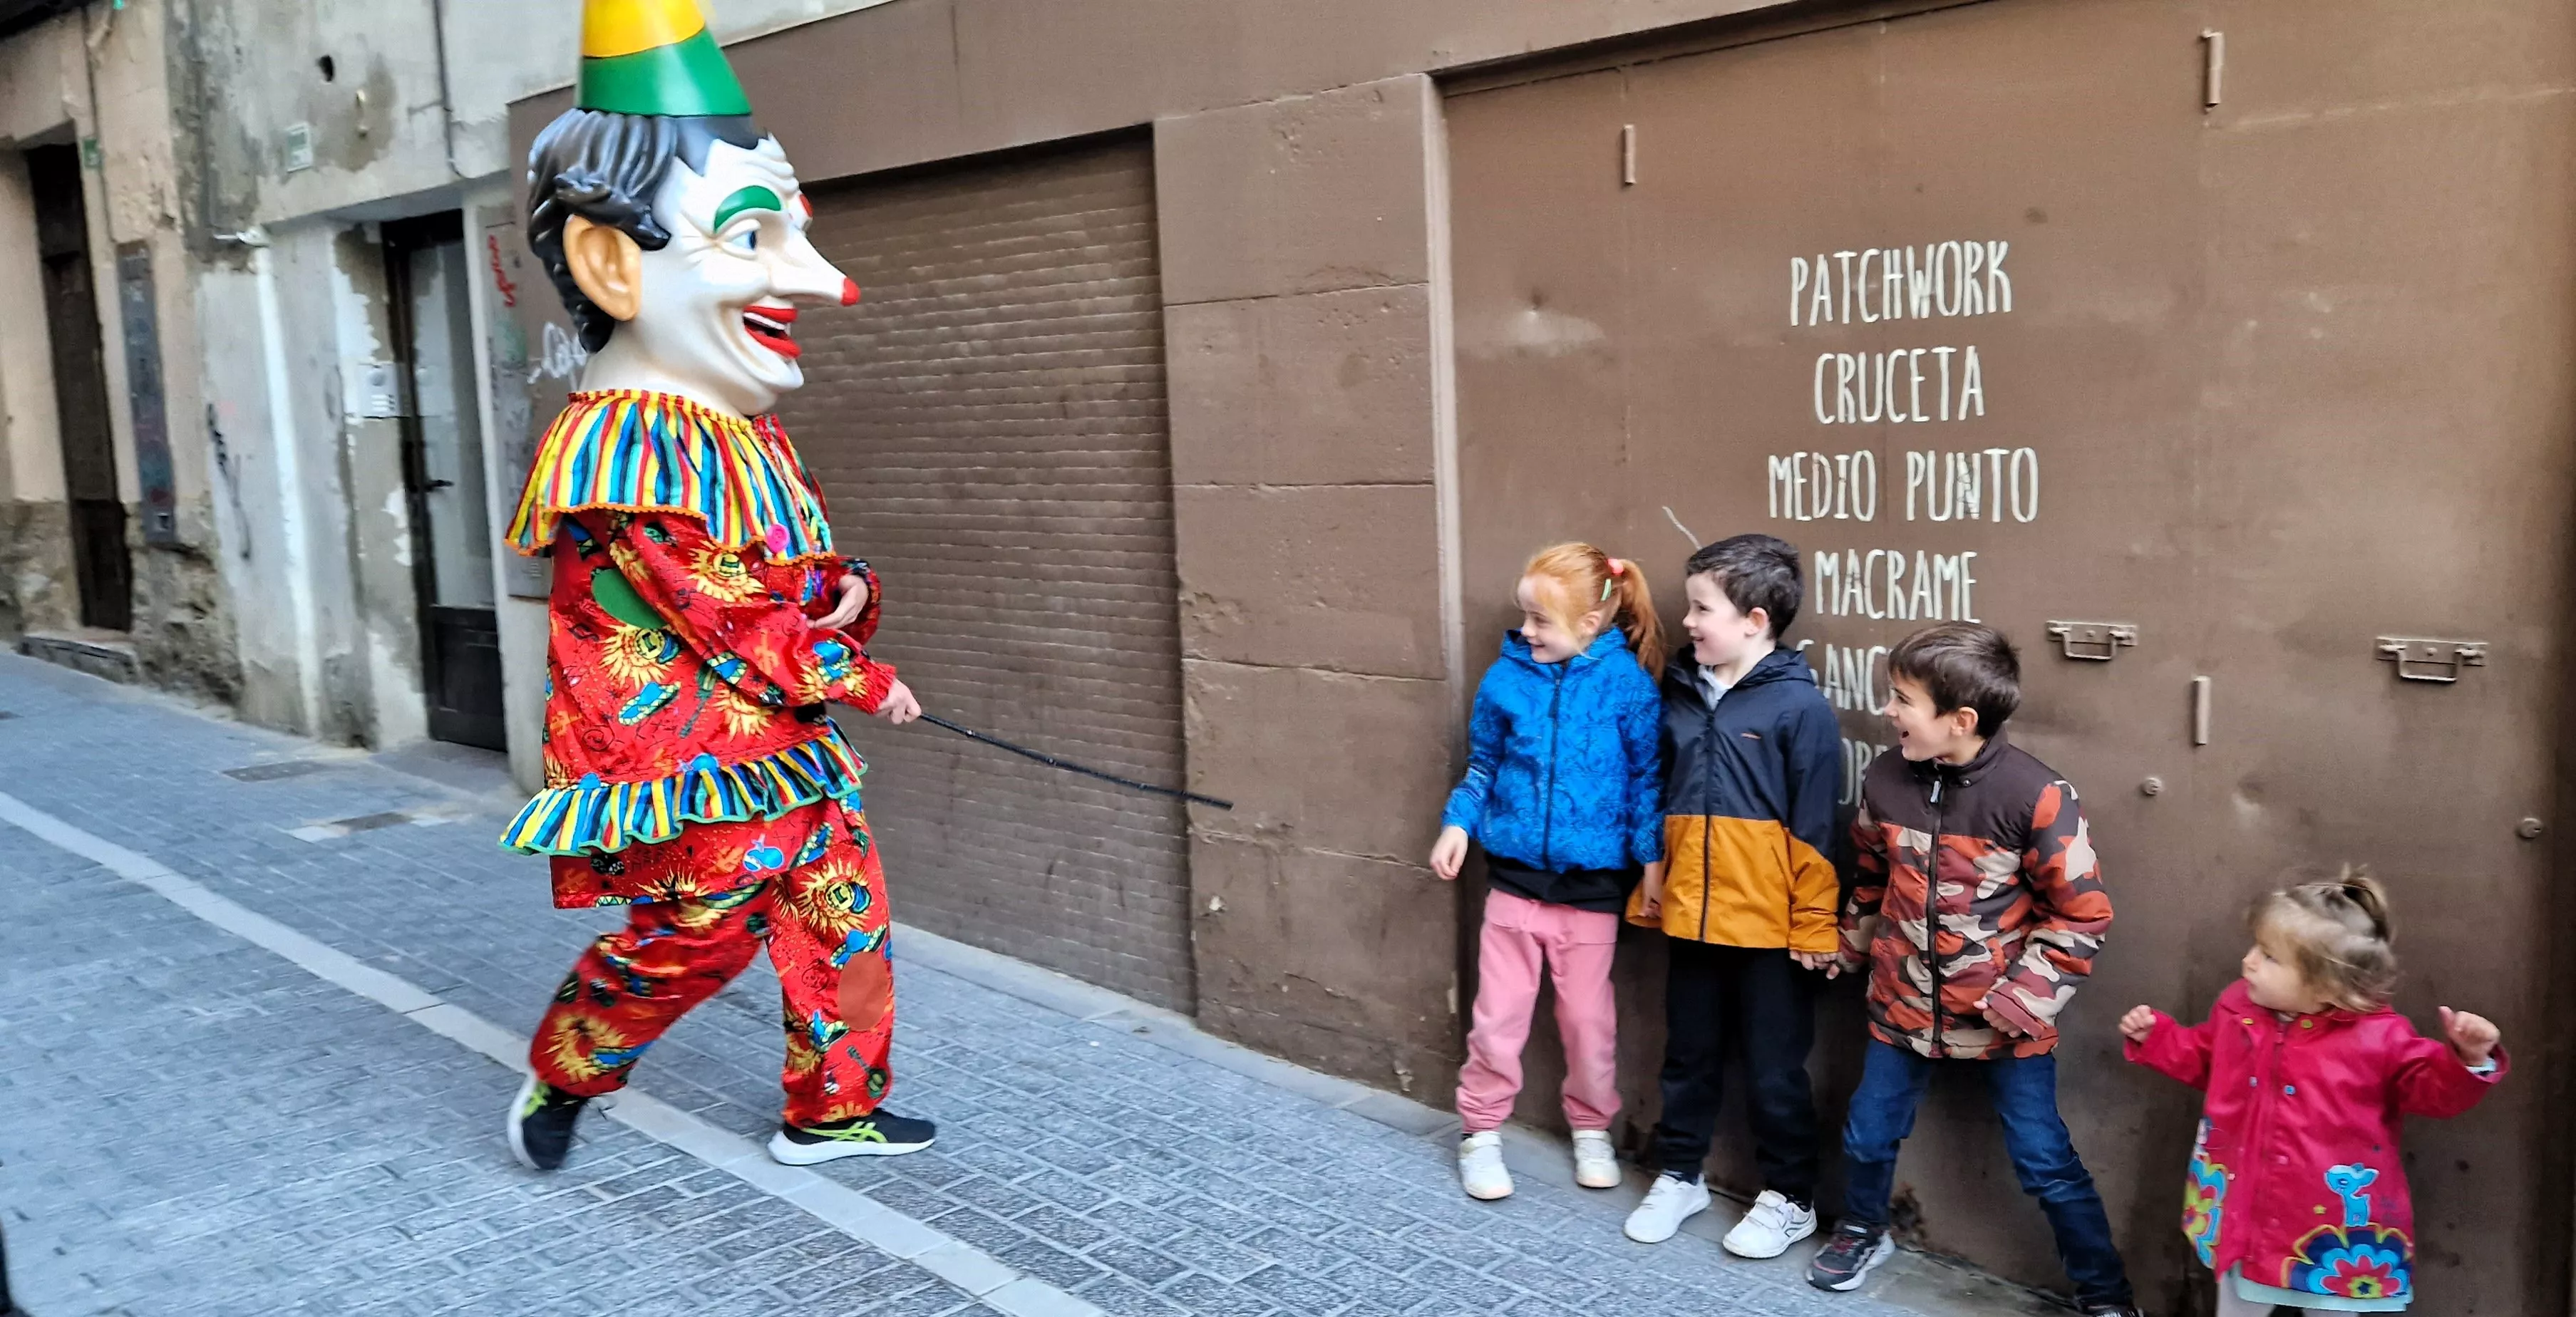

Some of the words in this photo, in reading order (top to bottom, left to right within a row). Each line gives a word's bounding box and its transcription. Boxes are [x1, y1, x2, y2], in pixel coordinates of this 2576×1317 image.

[1790, 240, 2012, 326] PATCHWORK
[1814, 345, 1985, 424] CRUCETA
[1768, 450, 1876, 522] MEDIO
[1905, 447, 2039, 523] PUNTO
[1814, 548, 1982, 624] MACRAME
